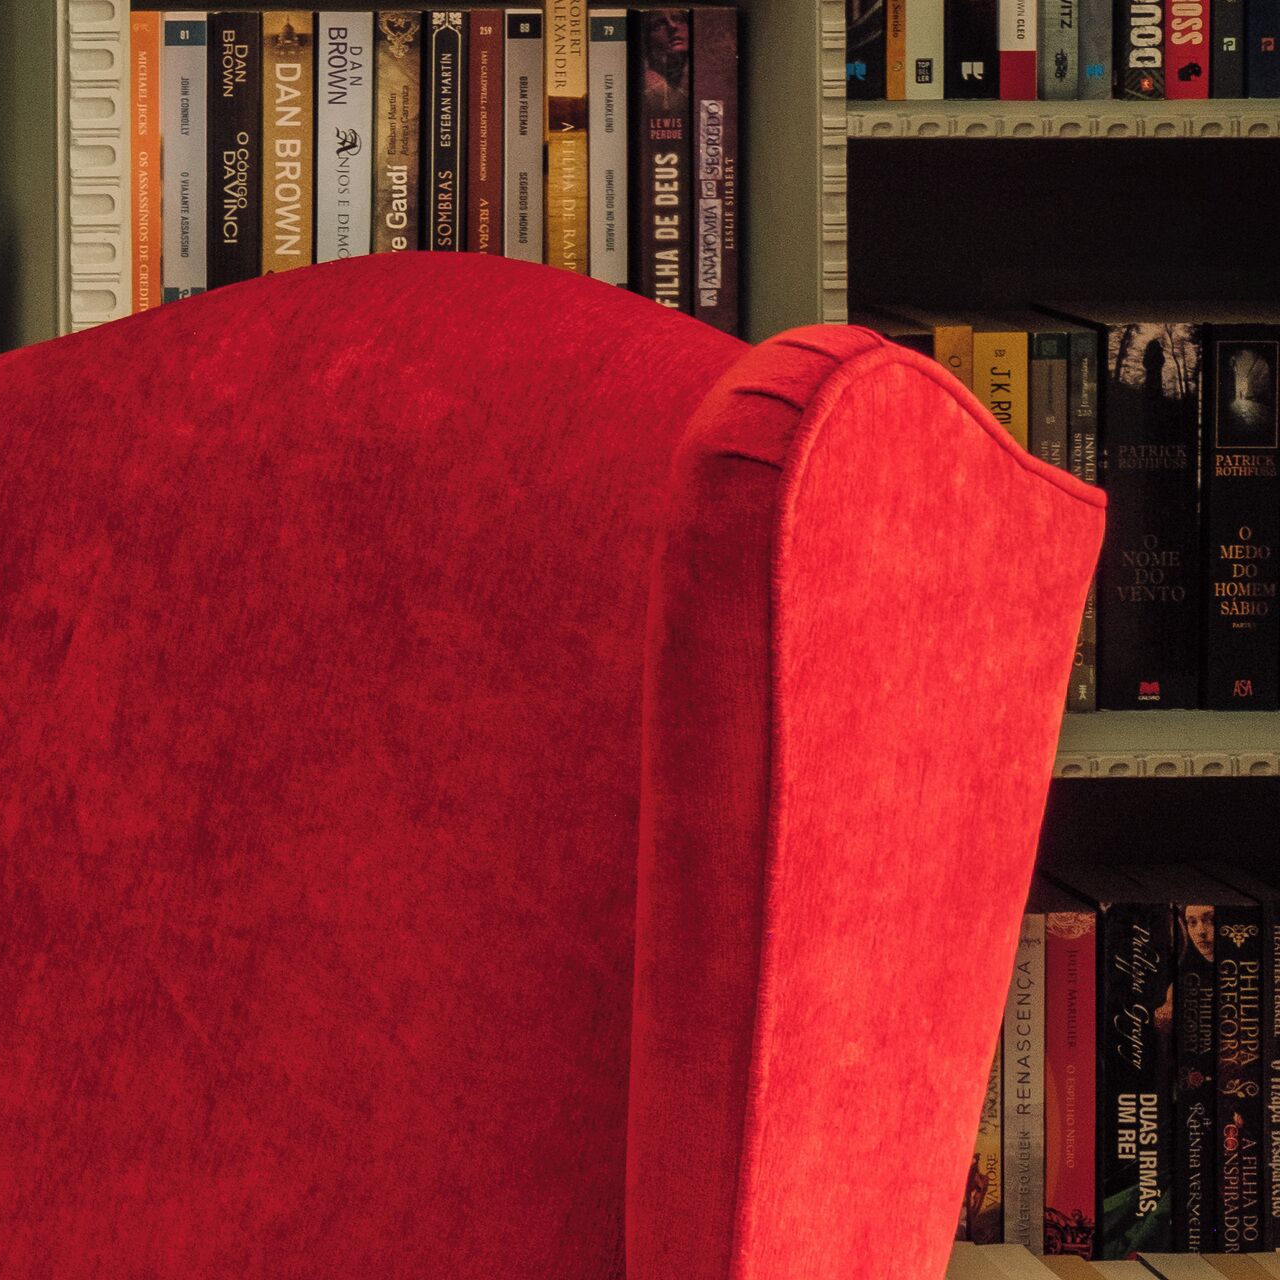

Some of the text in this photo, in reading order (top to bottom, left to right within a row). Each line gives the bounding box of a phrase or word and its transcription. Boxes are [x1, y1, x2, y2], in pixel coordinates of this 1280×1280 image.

[180, 30, 190, 39] 81
[222, 30, 233, 98] BROWN
[235, 45, 248, 83] DAN
[327, 26, 348, 105] BROWN
[350, 46, 363, 87] DAN
[273, 63, 302, 256] DAN BROWN
[438, 169, 452, 246] SOMBRAS
[1118, 1093, 1136, 1159] UM REI
[1136, 1093, 1162, 1217] DUAS IRMÃS,
